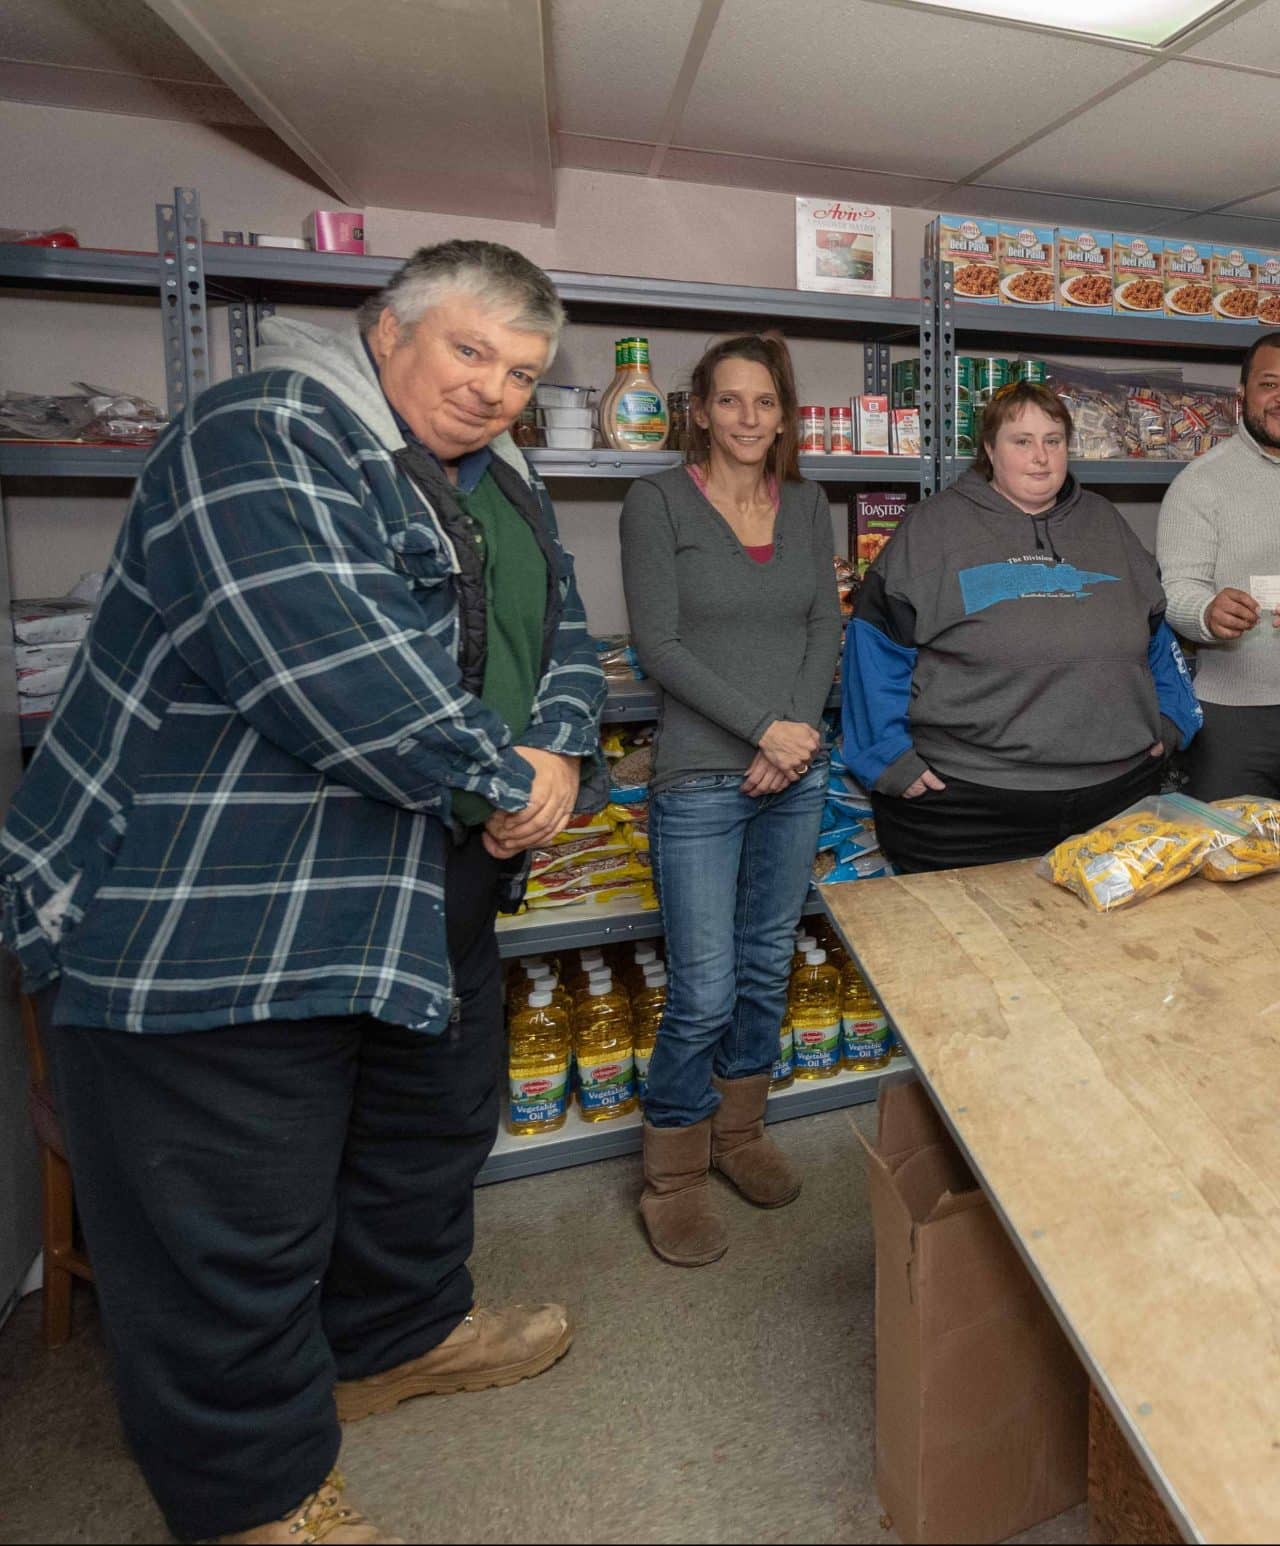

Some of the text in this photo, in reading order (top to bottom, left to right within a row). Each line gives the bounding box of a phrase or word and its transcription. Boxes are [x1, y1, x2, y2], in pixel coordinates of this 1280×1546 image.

[968, 240, 989, 253] Pasta
[1026, 248, 1046, 260] Pasta
[1085, 252, 1104, 264] Pasta
[859, 502, 905, 518] TOASTEDS
[849, 1042, 882, 1052] Vegetable
[797, 1051, 831, 1062] Vegetable
[859, 1049, 871, 1057] Oil
[807, 1058, 820, 1067] Oil
[588, 1085, 628, 1099] Vegetable
[601, 1096, 616, 1105] Oil
[516, 1102, 557, 1114] Vegetable
[529, 1112, 544, 1121] Oil
